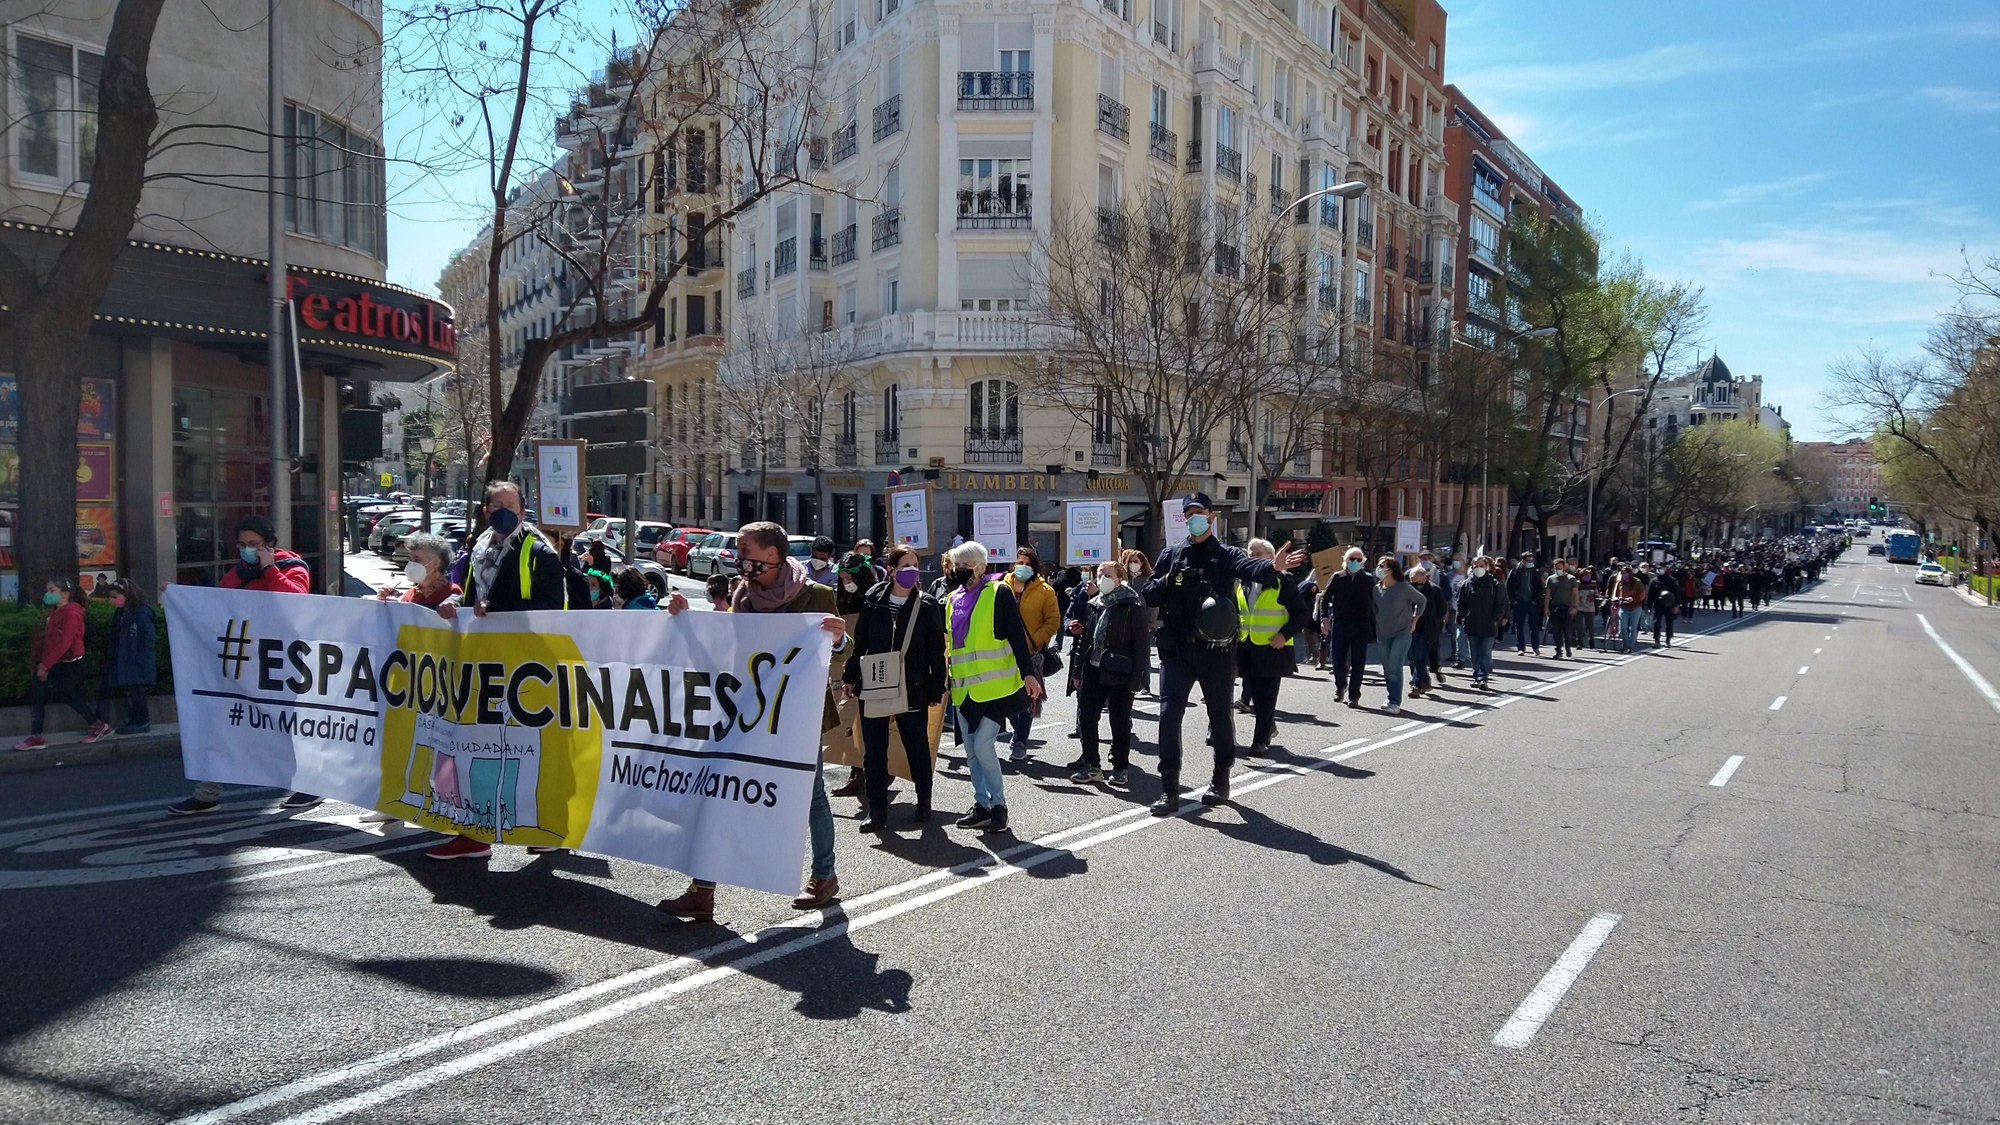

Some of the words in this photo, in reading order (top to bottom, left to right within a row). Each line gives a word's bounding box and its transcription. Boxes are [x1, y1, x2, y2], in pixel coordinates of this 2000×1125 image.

[278, 710, 359, 744] Madrid
[362, 726, 377, 747] a
[449, 740, 536, 757] CIUDADANA
[610, 754, 692, 795] Muchas
[689, 764, 779, 808] Manos
